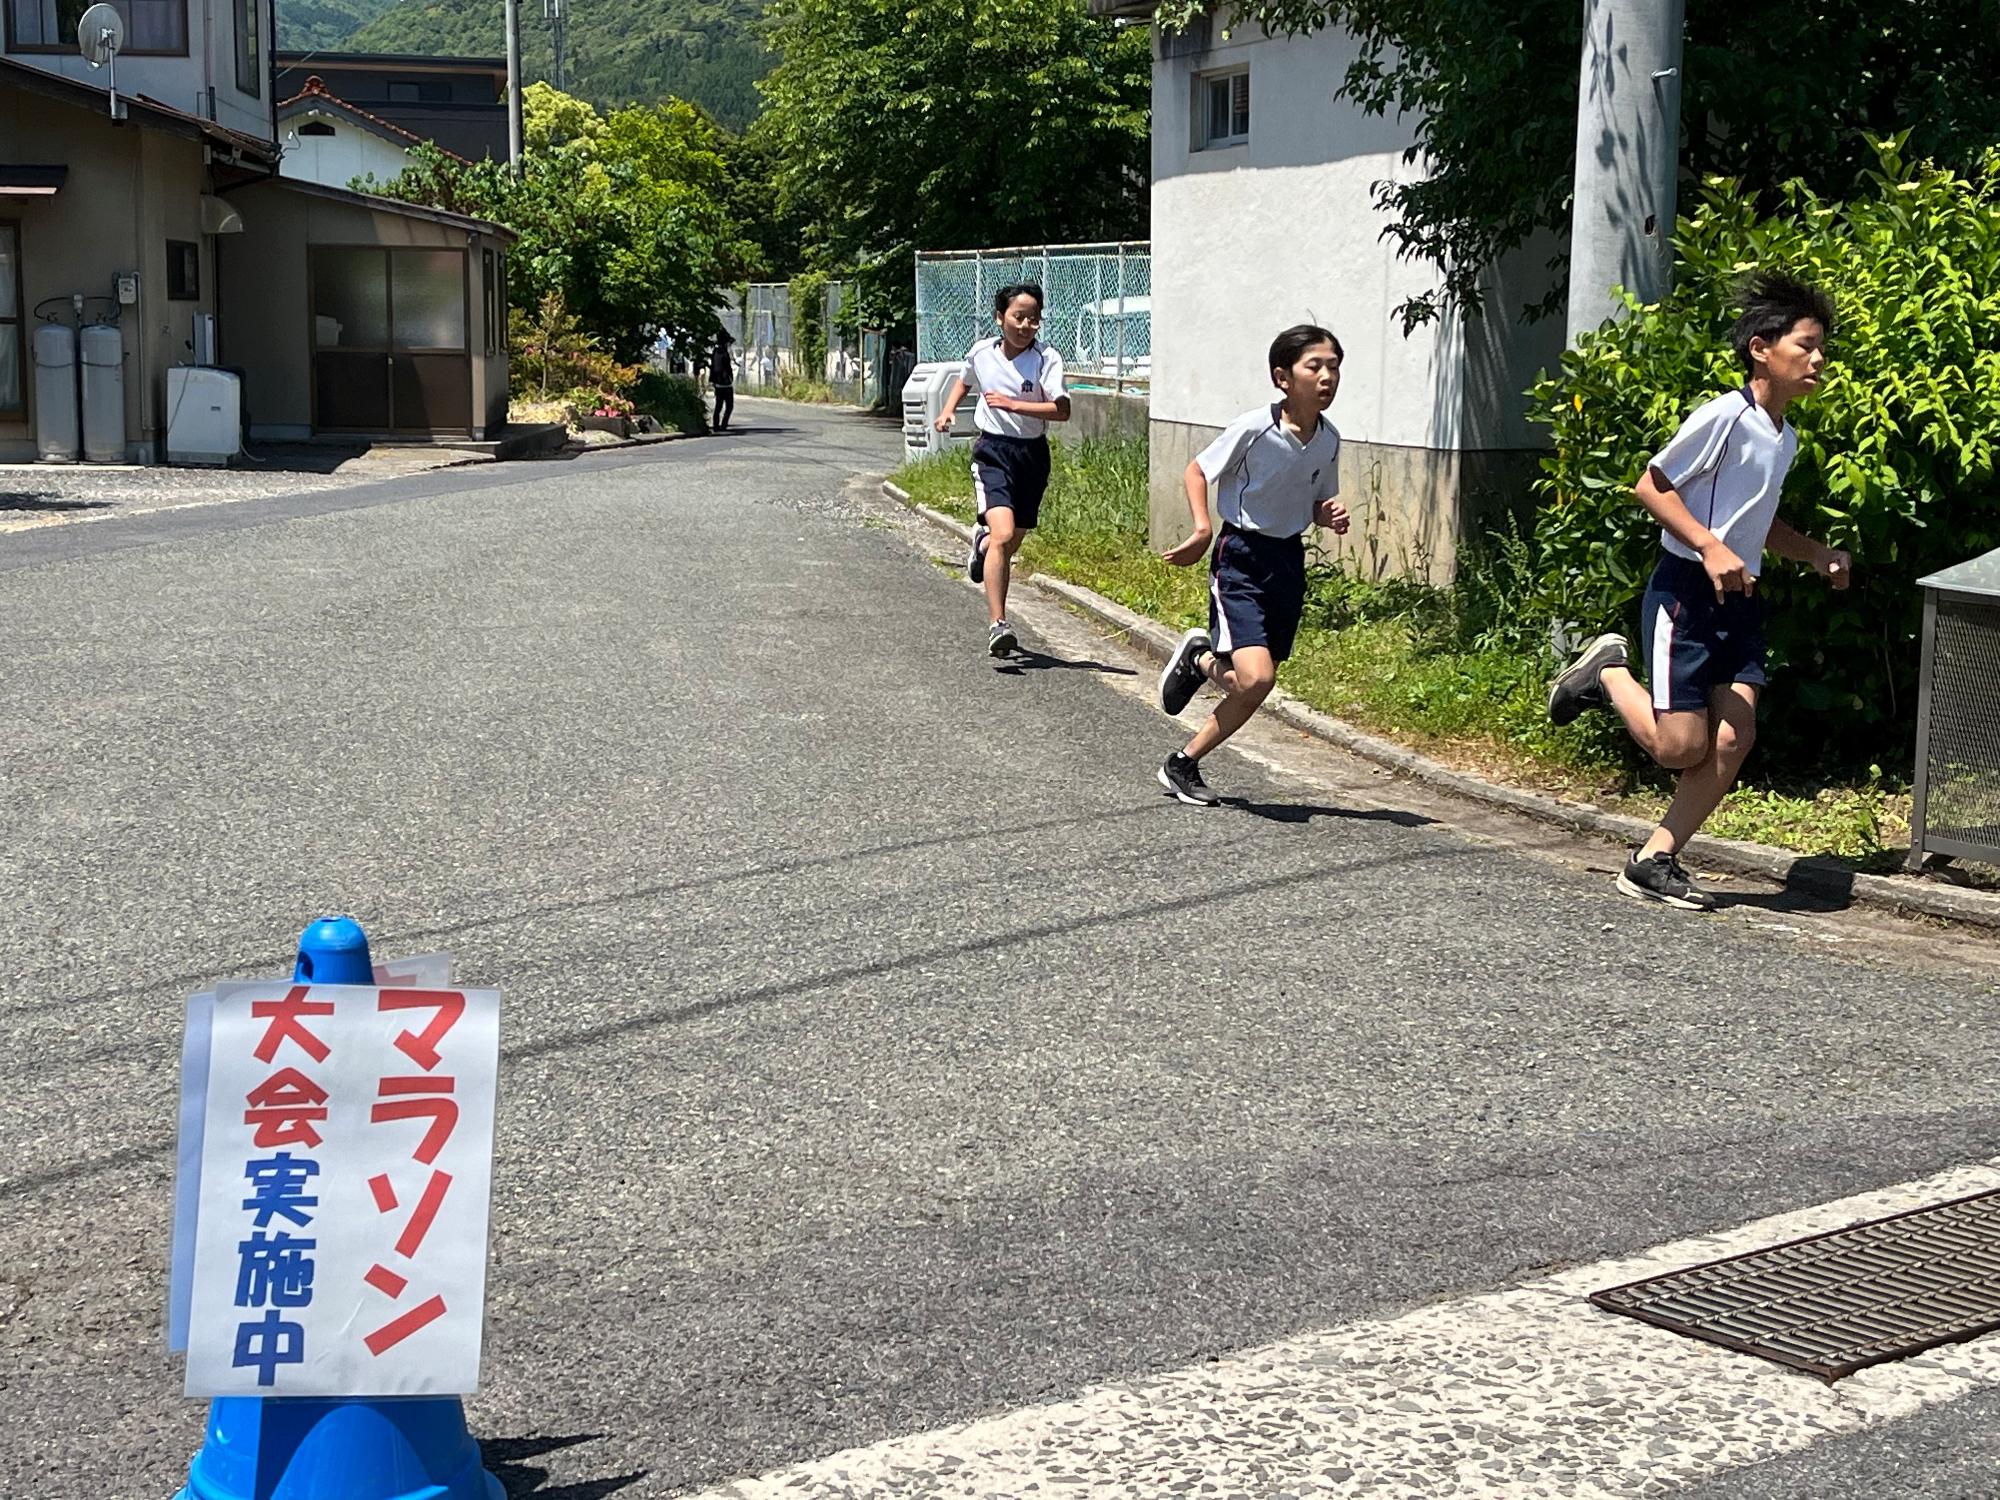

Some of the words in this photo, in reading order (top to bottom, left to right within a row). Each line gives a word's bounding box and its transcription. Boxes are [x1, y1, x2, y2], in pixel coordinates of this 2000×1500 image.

[232, 986, 335, 1387] 大会実施中
[364, 989, 466, 1356] マラソン
